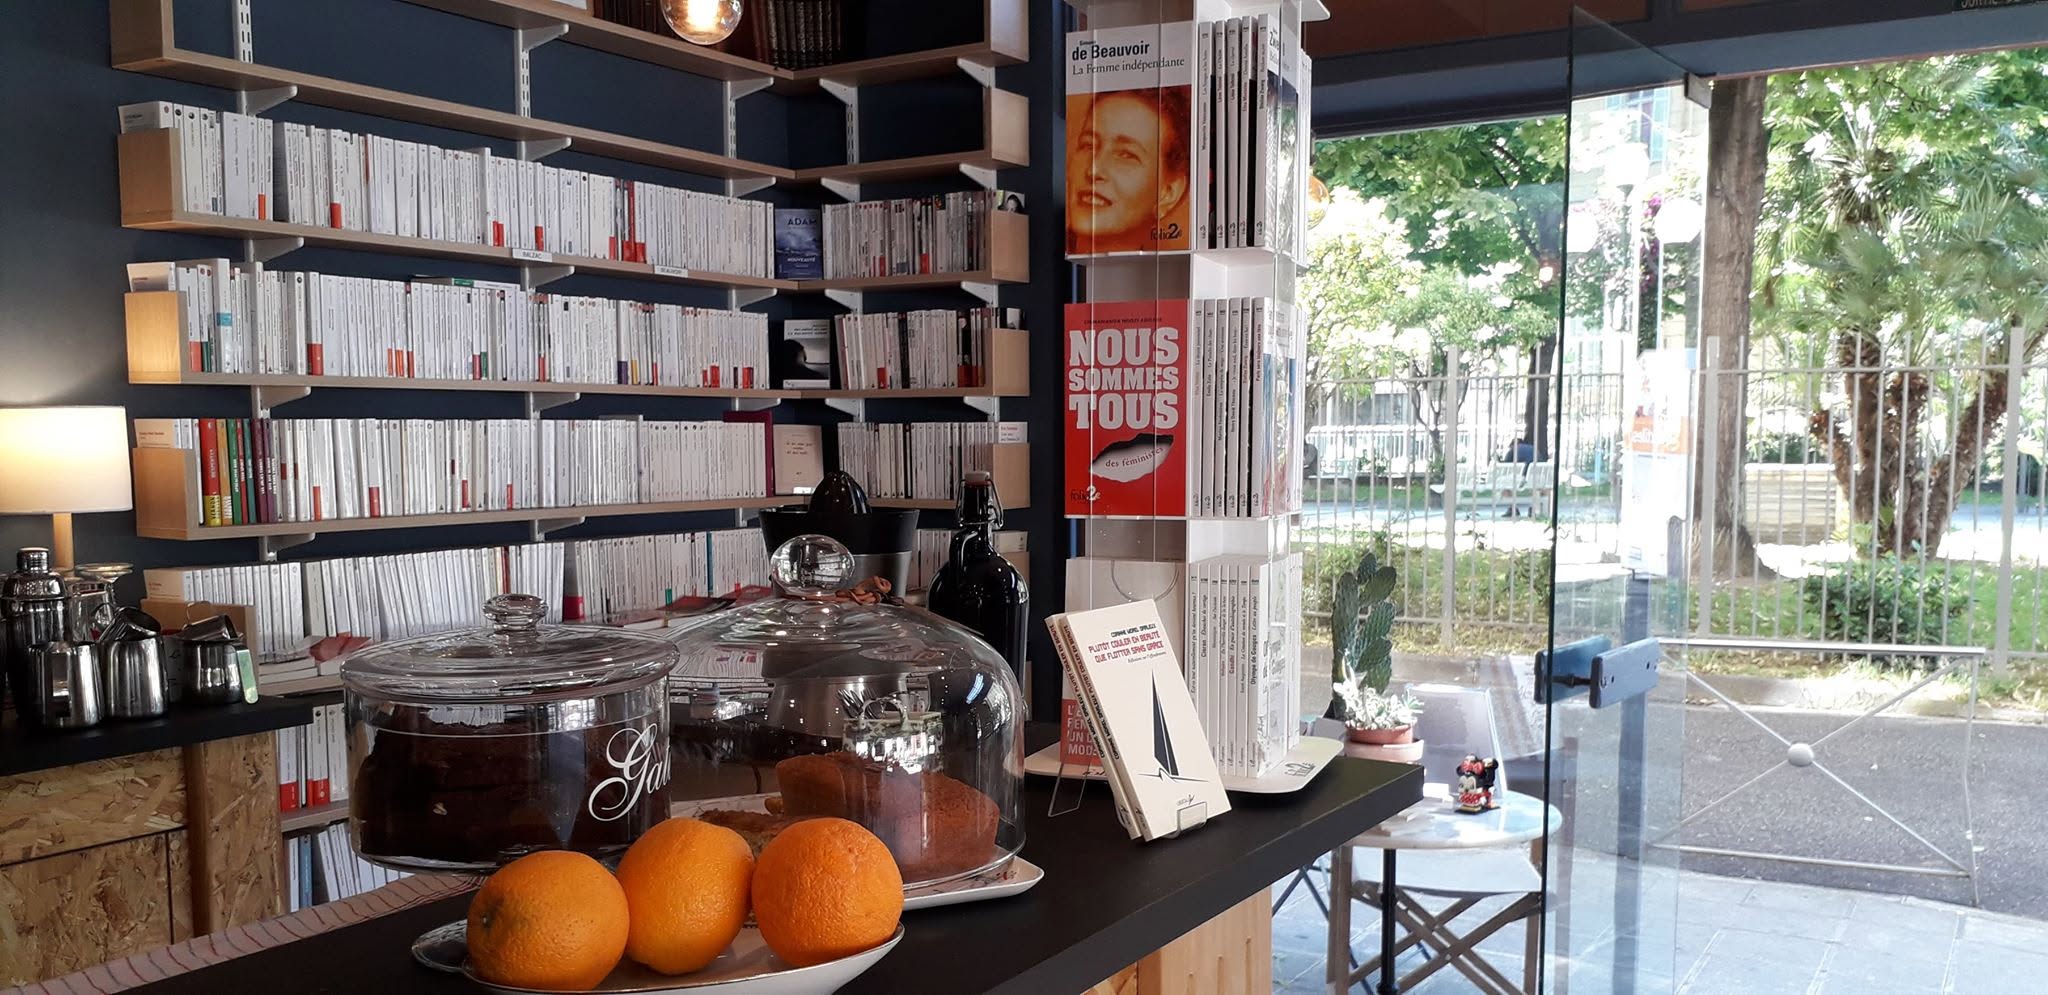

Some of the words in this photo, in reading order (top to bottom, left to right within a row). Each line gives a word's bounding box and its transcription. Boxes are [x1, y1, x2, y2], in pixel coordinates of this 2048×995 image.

[1072, 47, 1087, 60] de
[1091, 41, 1150, 59] Beauvoir
[1073, 65, 1083, 75] La
[1086, 62, 1120, 74] Femme
[1122, 57, 1185, 72] indépendante
[1070, 327, 1179, 366] NOUS
[1069, 366, 1179, 391] SOMMES
[1069, 392, 1179, 430] TOUS
[1105, 459, 1119, 468] des
[1122, 447, 1164, 467] féministes
[1088, 641, 1110, 653] PLUTÔT
[1110, 637, 1131, 649] COULER
[1131, 635, 1140, 644] EN
[1139, 630, 1160, 642] BEAUTÉ
[1094, 653, 1107, 663] QUE
[1107, 647, 1131, 660] FLOTTER
[1131, 644, 1147, 655] SANS
[1146, 640, 1164, 651] GRÂCE
